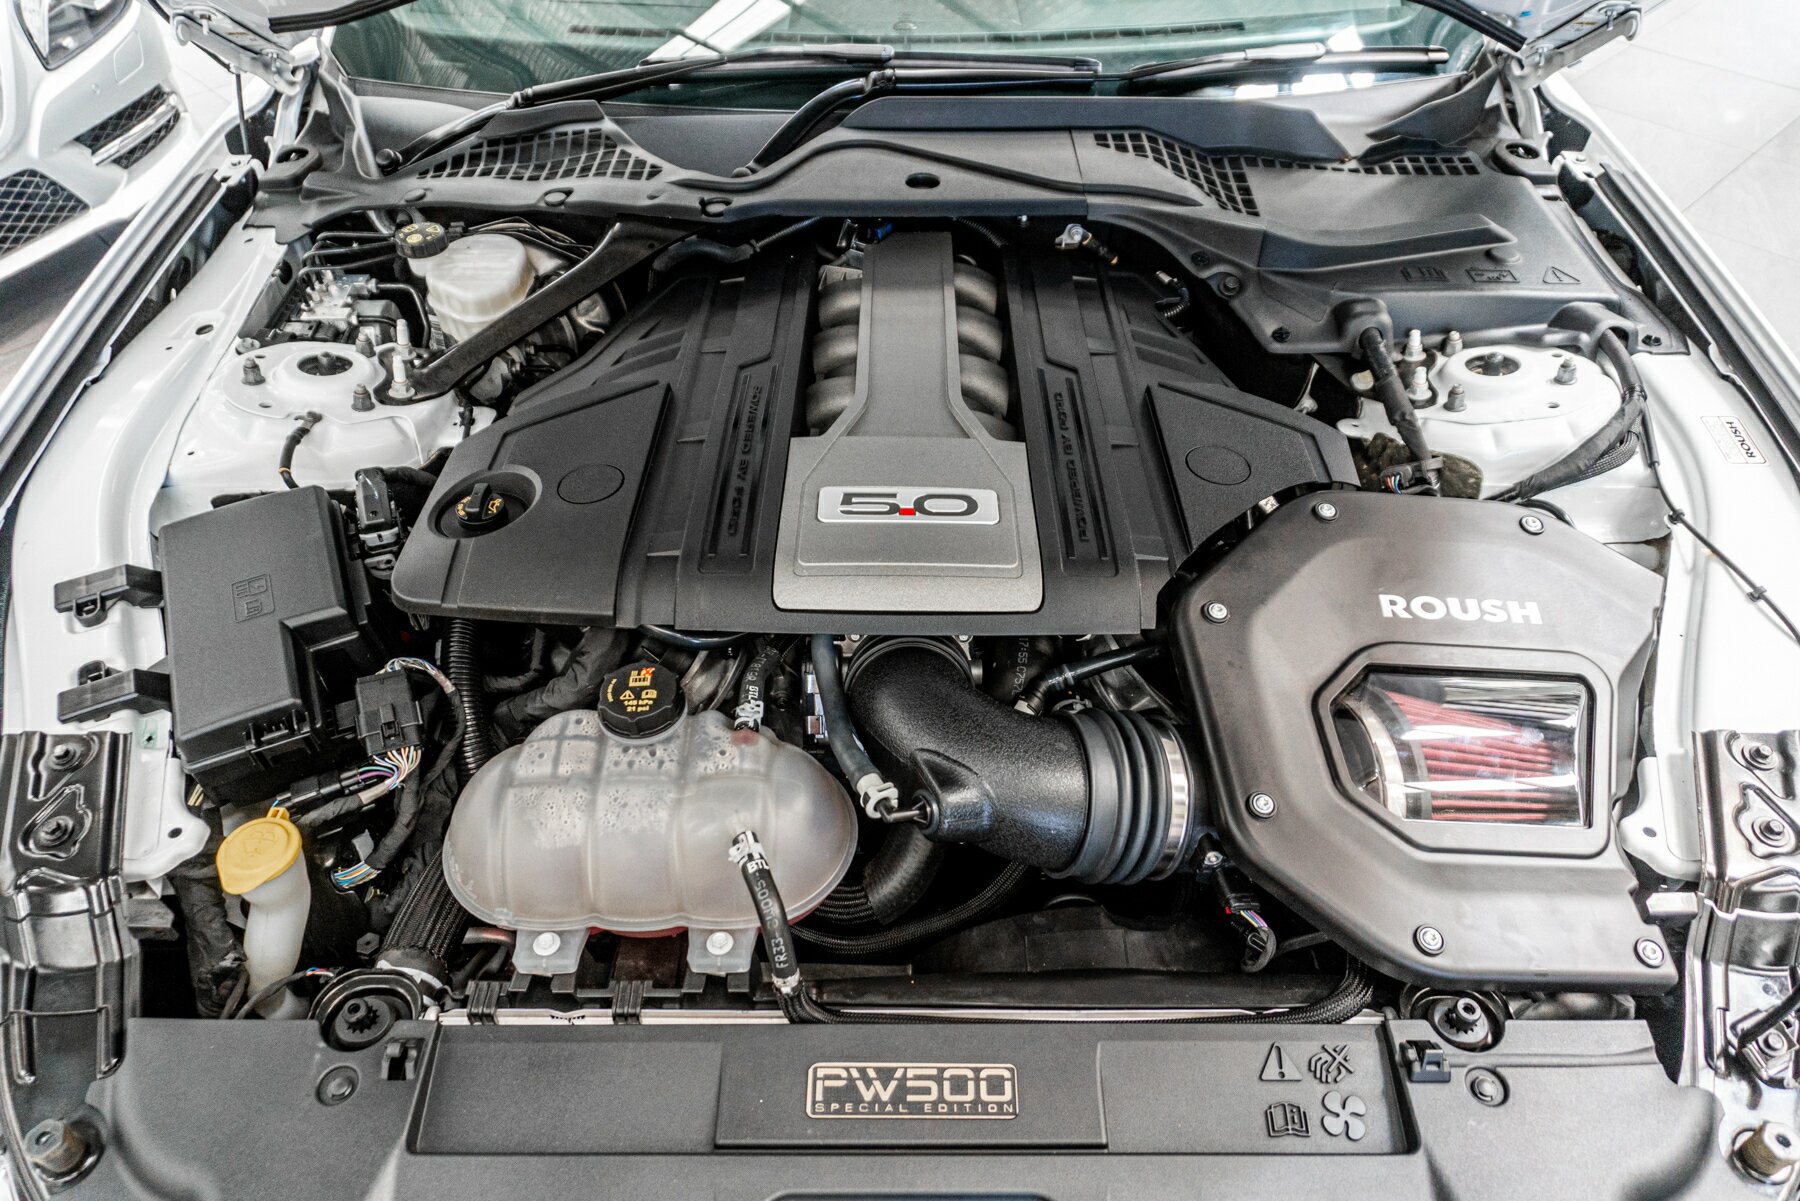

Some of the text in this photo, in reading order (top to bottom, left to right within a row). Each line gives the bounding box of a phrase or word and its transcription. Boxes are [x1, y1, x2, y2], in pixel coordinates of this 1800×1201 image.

[1725, 421, 1757, 459] ROUSH
[839, 492, 980, 518] 5.0
[1378, 593, 1544, 626] ROUSH
[815, 1067, 1013, 1102] PW500
[815, 1103, 1014, 1113] SPECIAL EDITION
